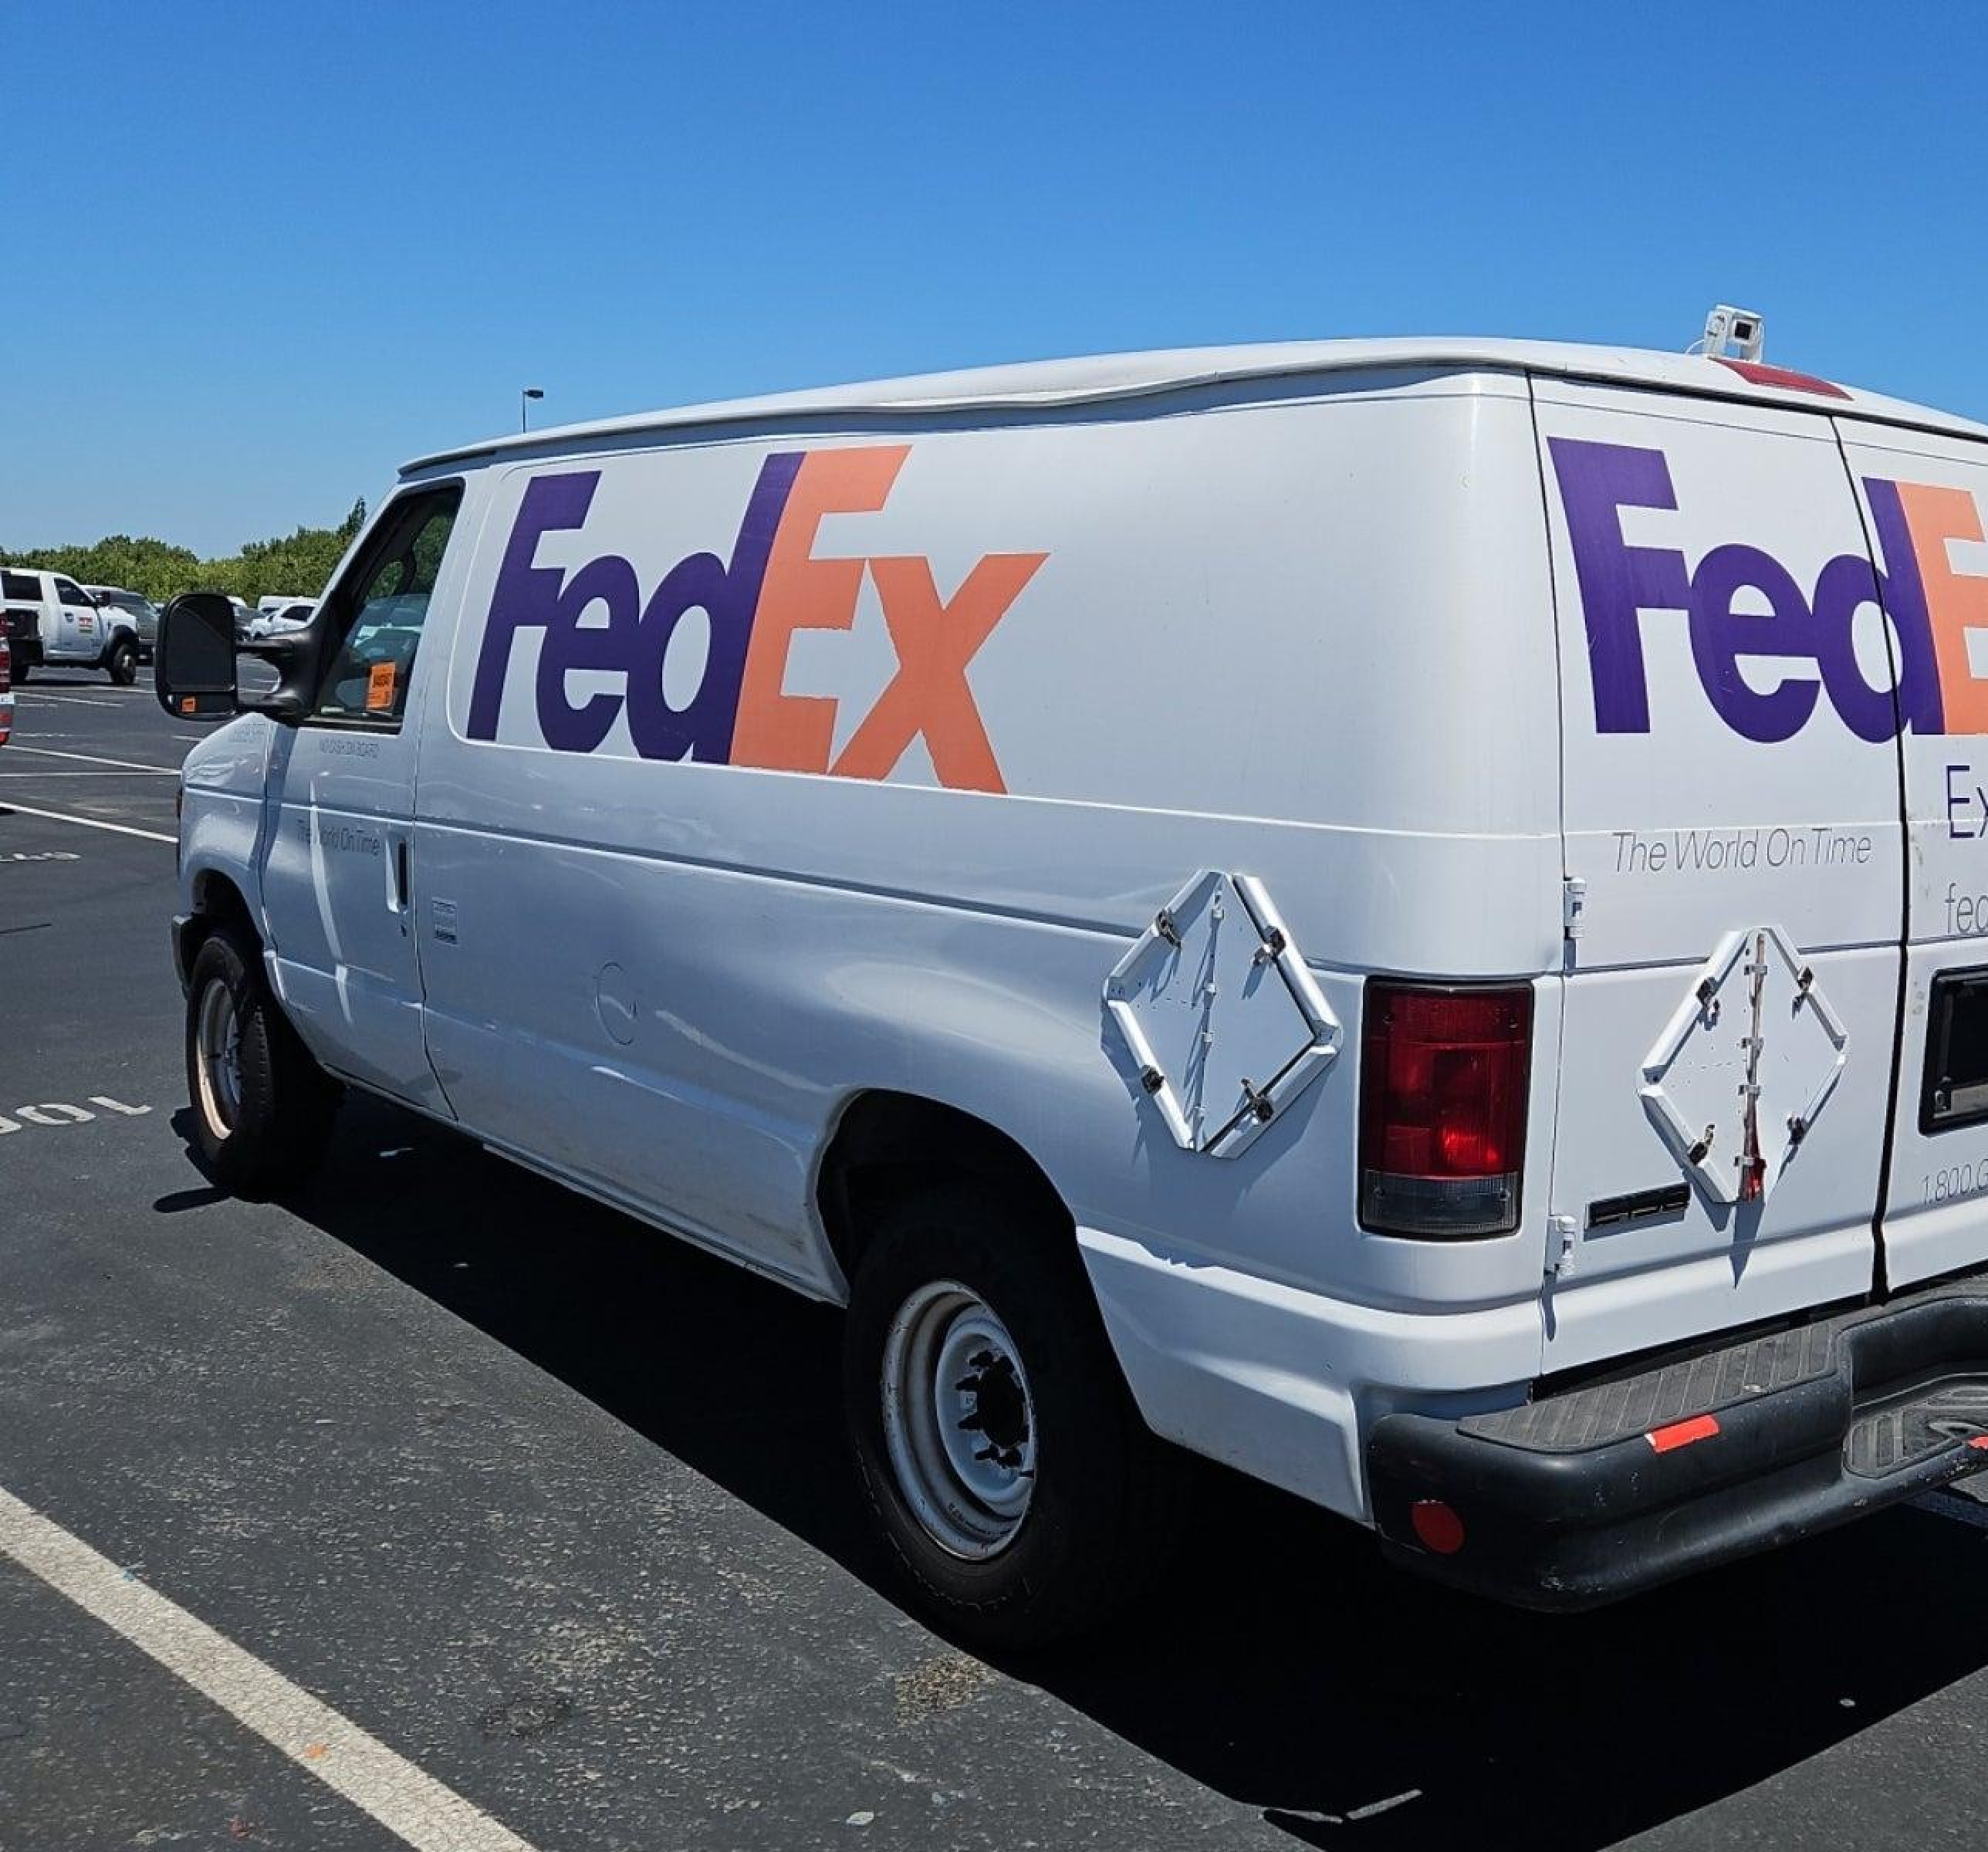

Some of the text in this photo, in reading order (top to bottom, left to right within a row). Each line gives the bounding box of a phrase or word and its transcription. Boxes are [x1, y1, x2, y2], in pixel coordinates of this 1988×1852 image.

[466, 445, 1050, 795] FedEx
[1612, 827, 1871, 872] The World On Time
